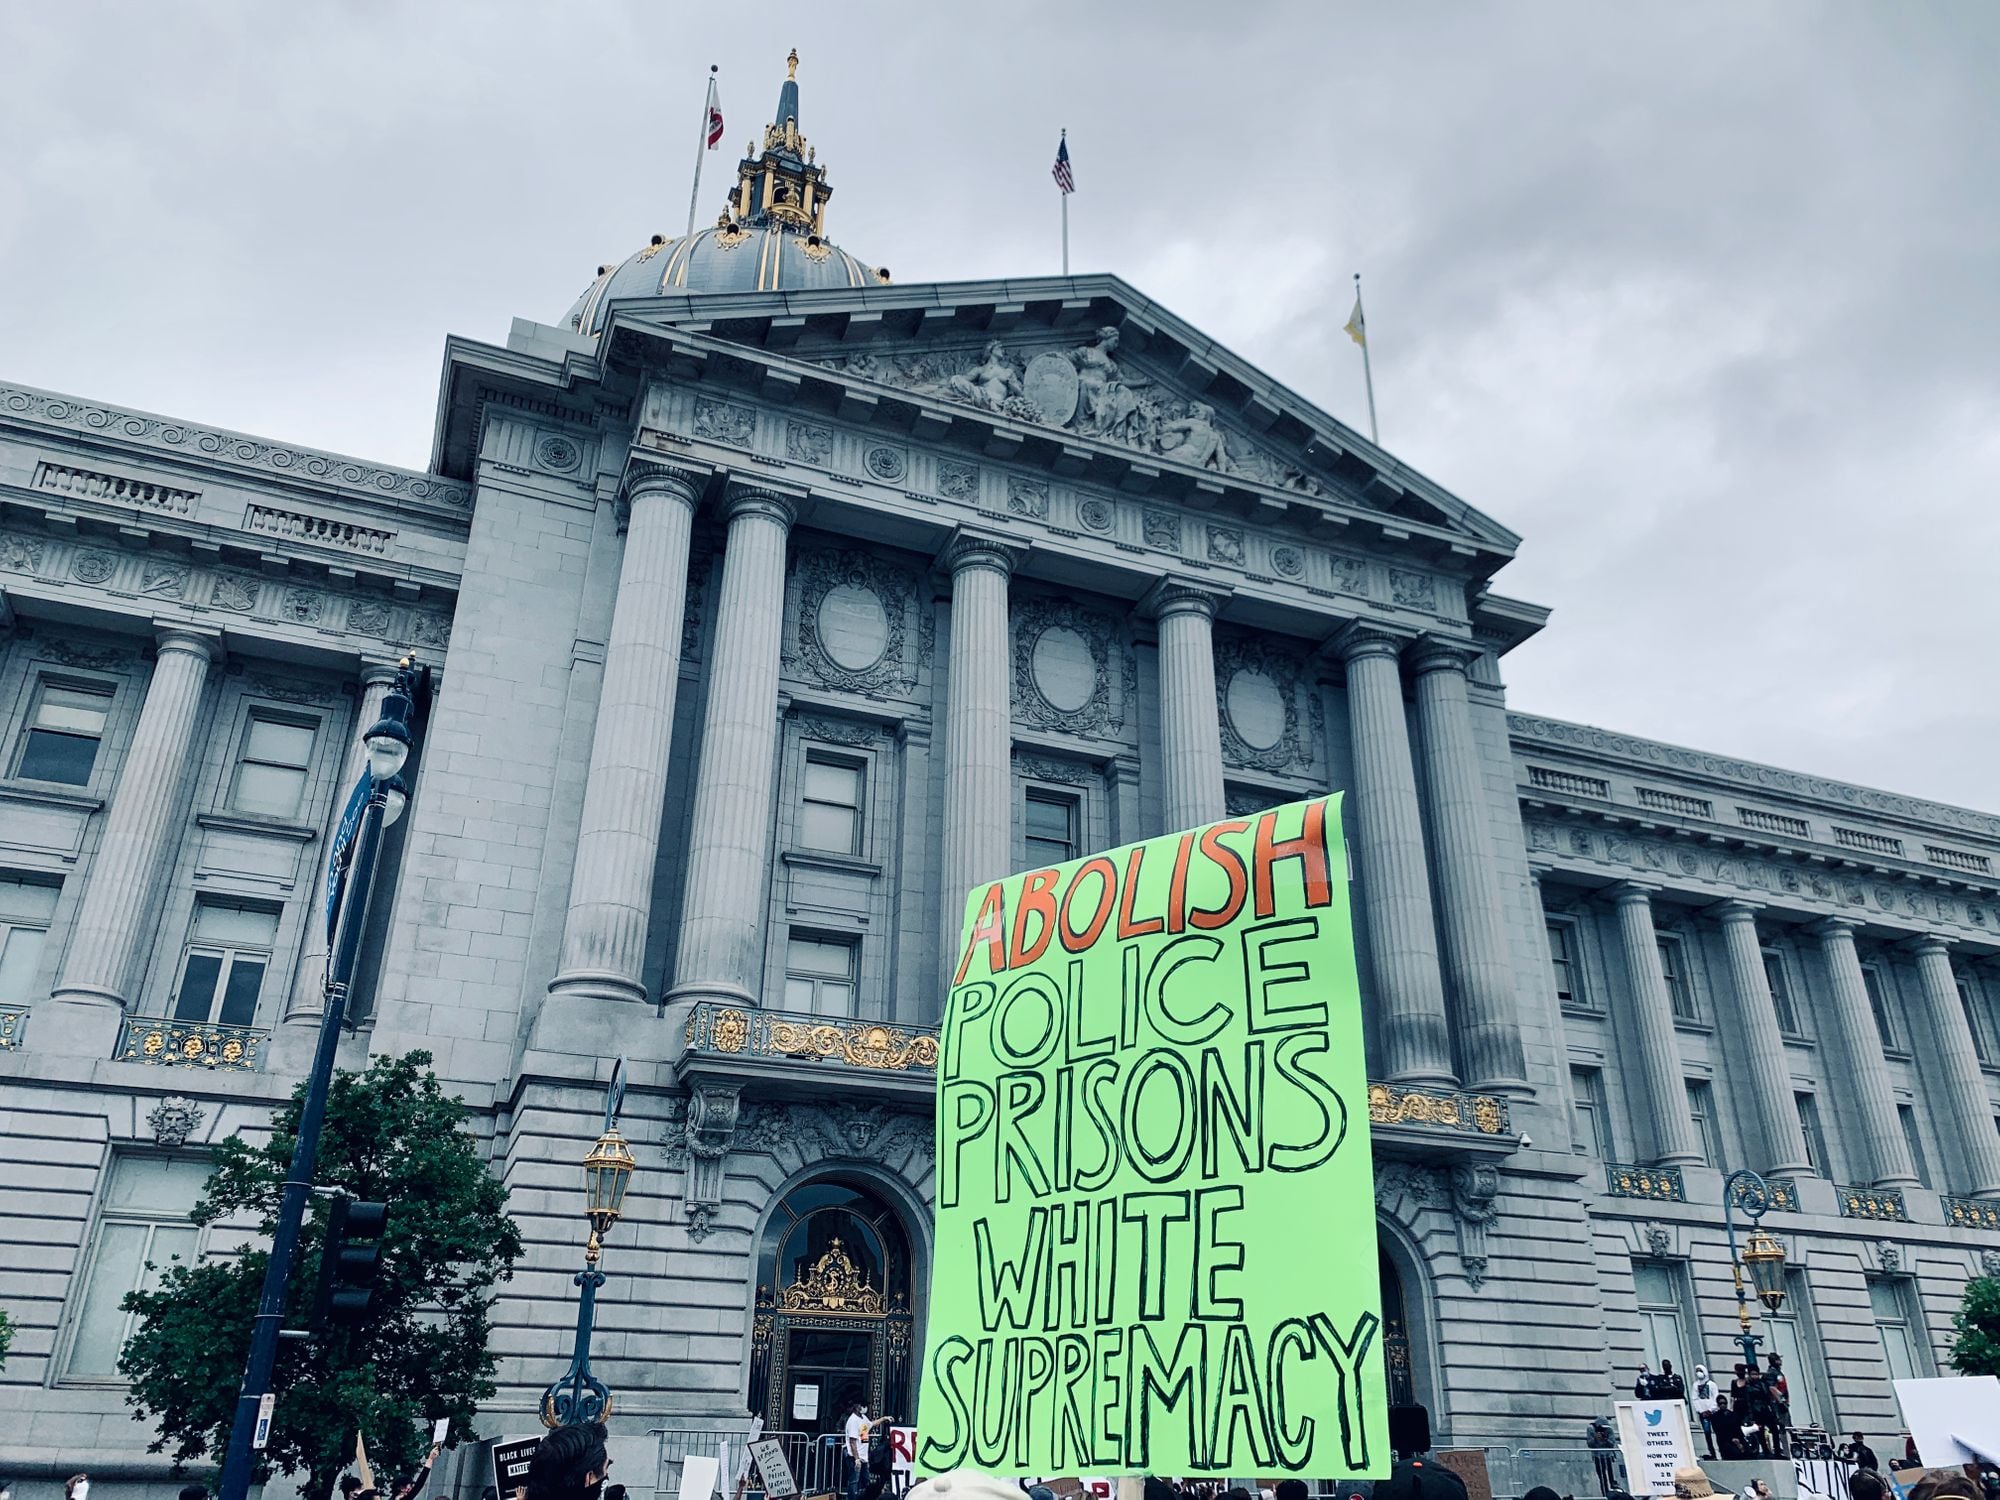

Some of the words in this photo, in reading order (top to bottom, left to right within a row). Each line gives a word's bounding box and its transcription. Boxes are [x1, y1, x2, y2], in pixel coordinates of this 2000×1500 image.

[954, 799, 1333, 987] ABOLISH
[943, 917, 1328, 1081] POLICE
[941, 1031, 1347, 1209] PRISONS
[973, 1185, 1245, 1333] WHITE
[499, 1450, 518, 1462] BLACK
[919, 1311, 1378, 1471] SUPREMACY
